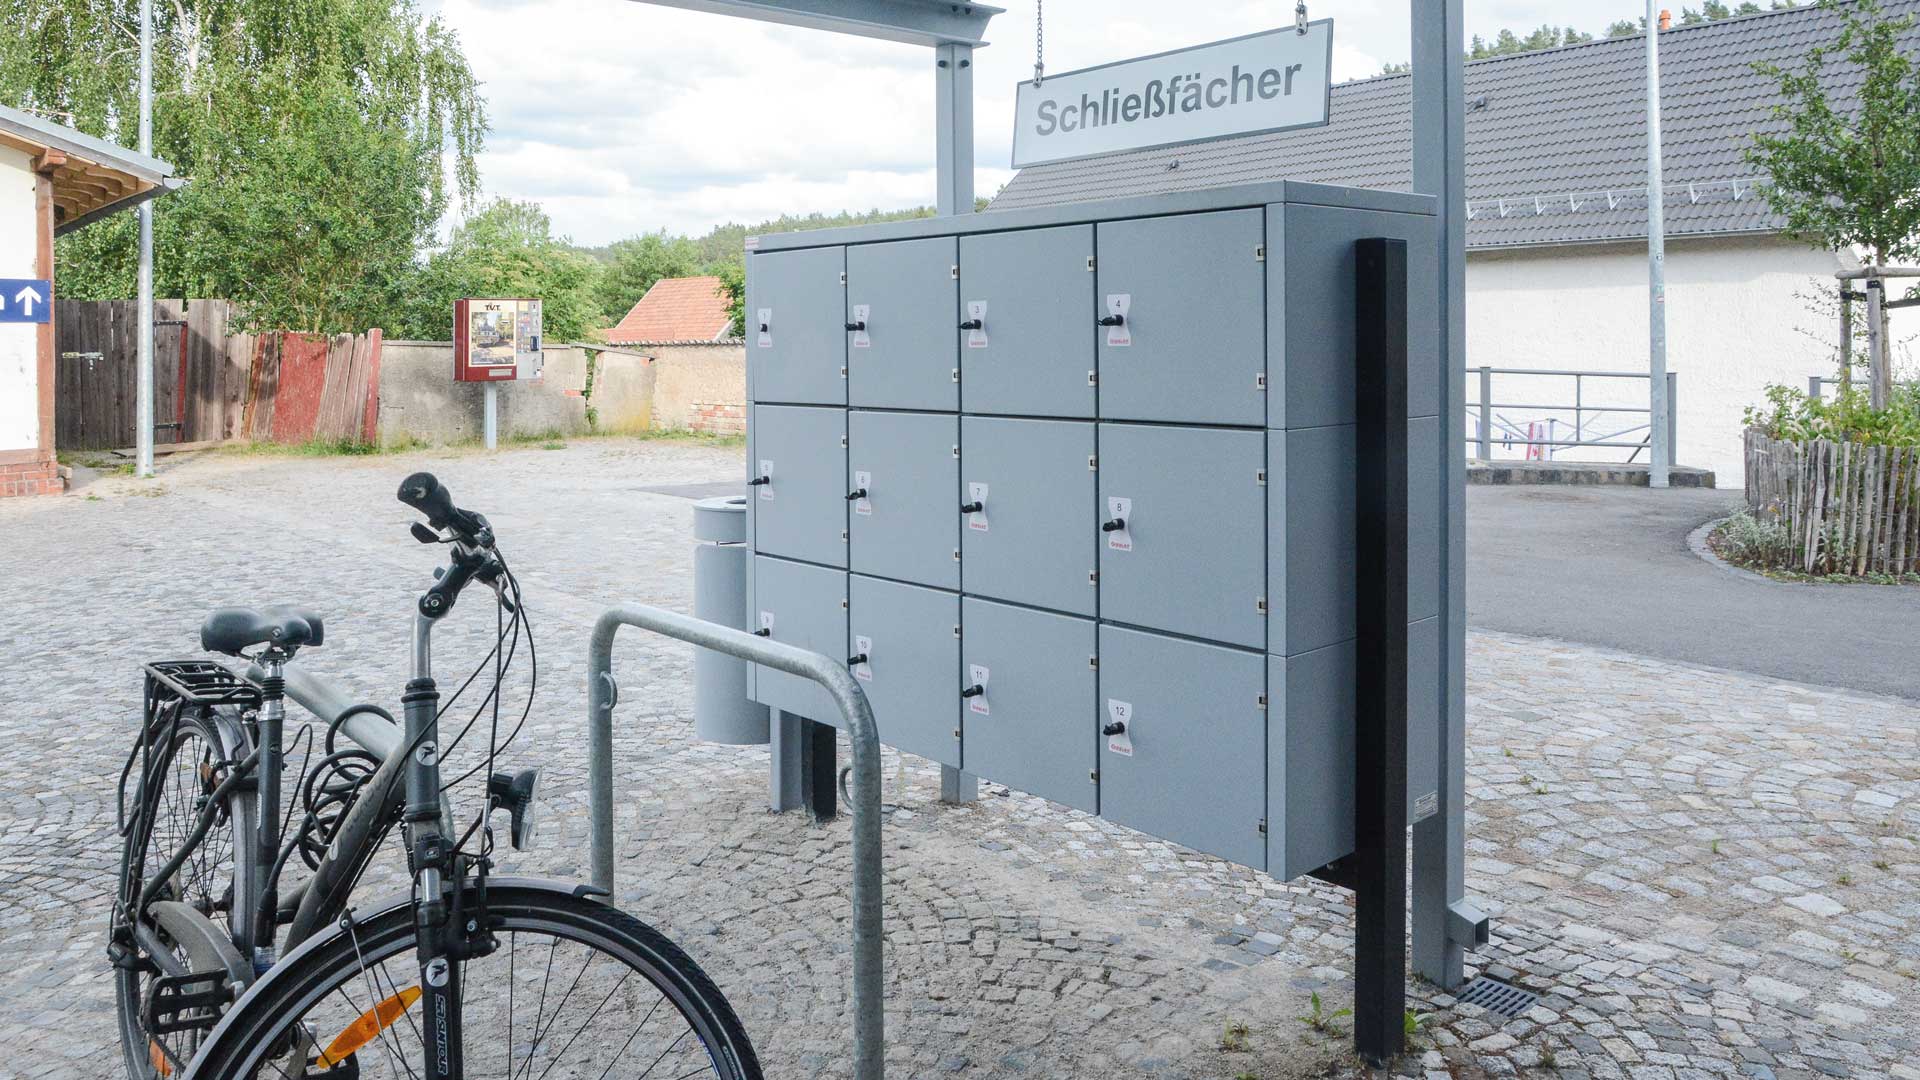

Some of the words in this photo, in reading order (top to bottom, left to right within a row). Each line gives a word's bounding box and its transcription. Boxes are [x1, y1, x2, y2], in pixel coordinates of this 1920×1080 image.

[1035, 64, 1302, 136] Schließfächer
[1115, 300, 1121, 308] 4
[1117, 503, 1122, 512] 8
[861, 640, 867, 649] 10
[976, 671, 983, 679] 11
[1116, 707, 1125, 716] 12
